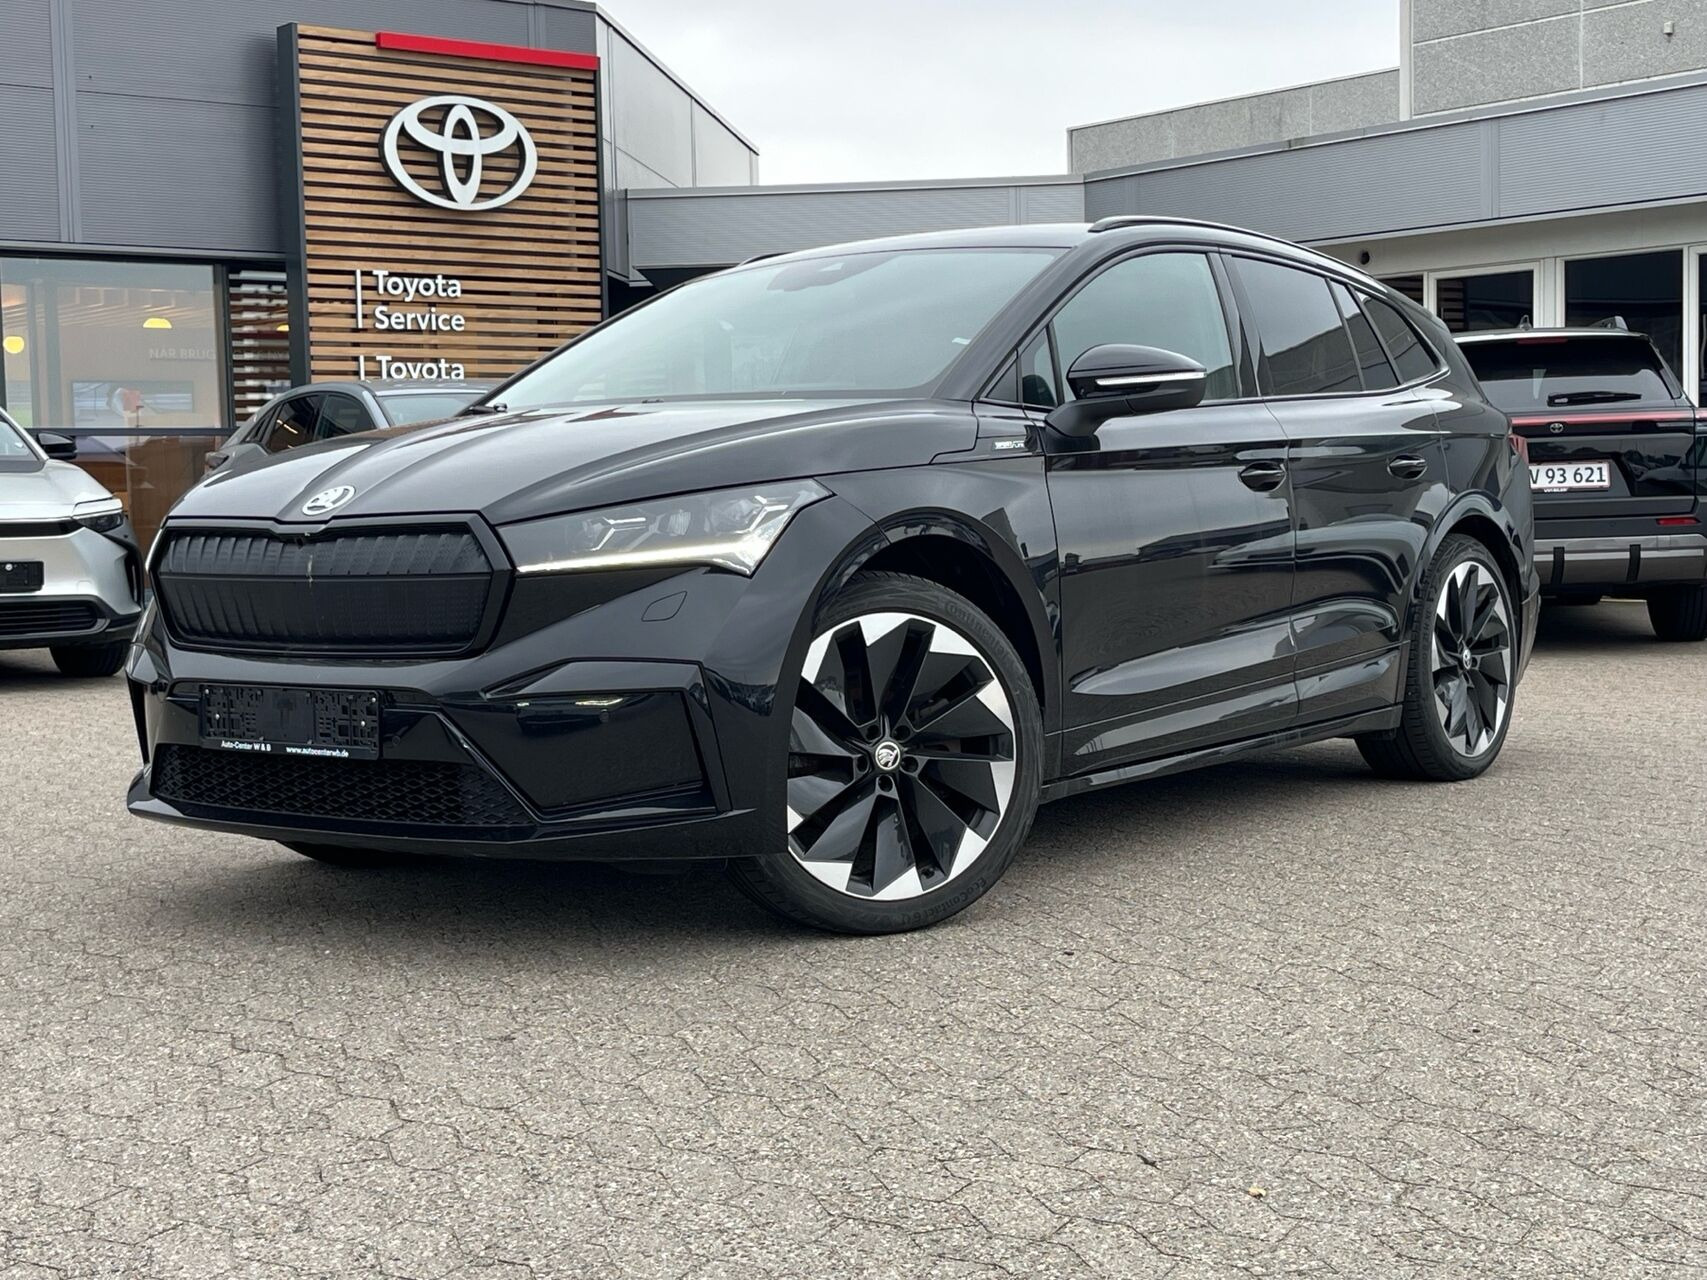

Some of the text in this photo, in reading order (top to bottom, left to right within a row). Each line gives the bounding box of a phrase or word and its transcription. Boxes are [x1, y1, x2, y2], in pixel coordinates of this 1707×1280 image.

[372, 269, 462, 302] Toyota
[374, 305, 466, 331] Service
[1545, 468, 1567, 484] 93
[1573, 467, 1606, 483] 621
[221, 740, 253, 750] Auto-Center
[253, 743, 261, 751] W
